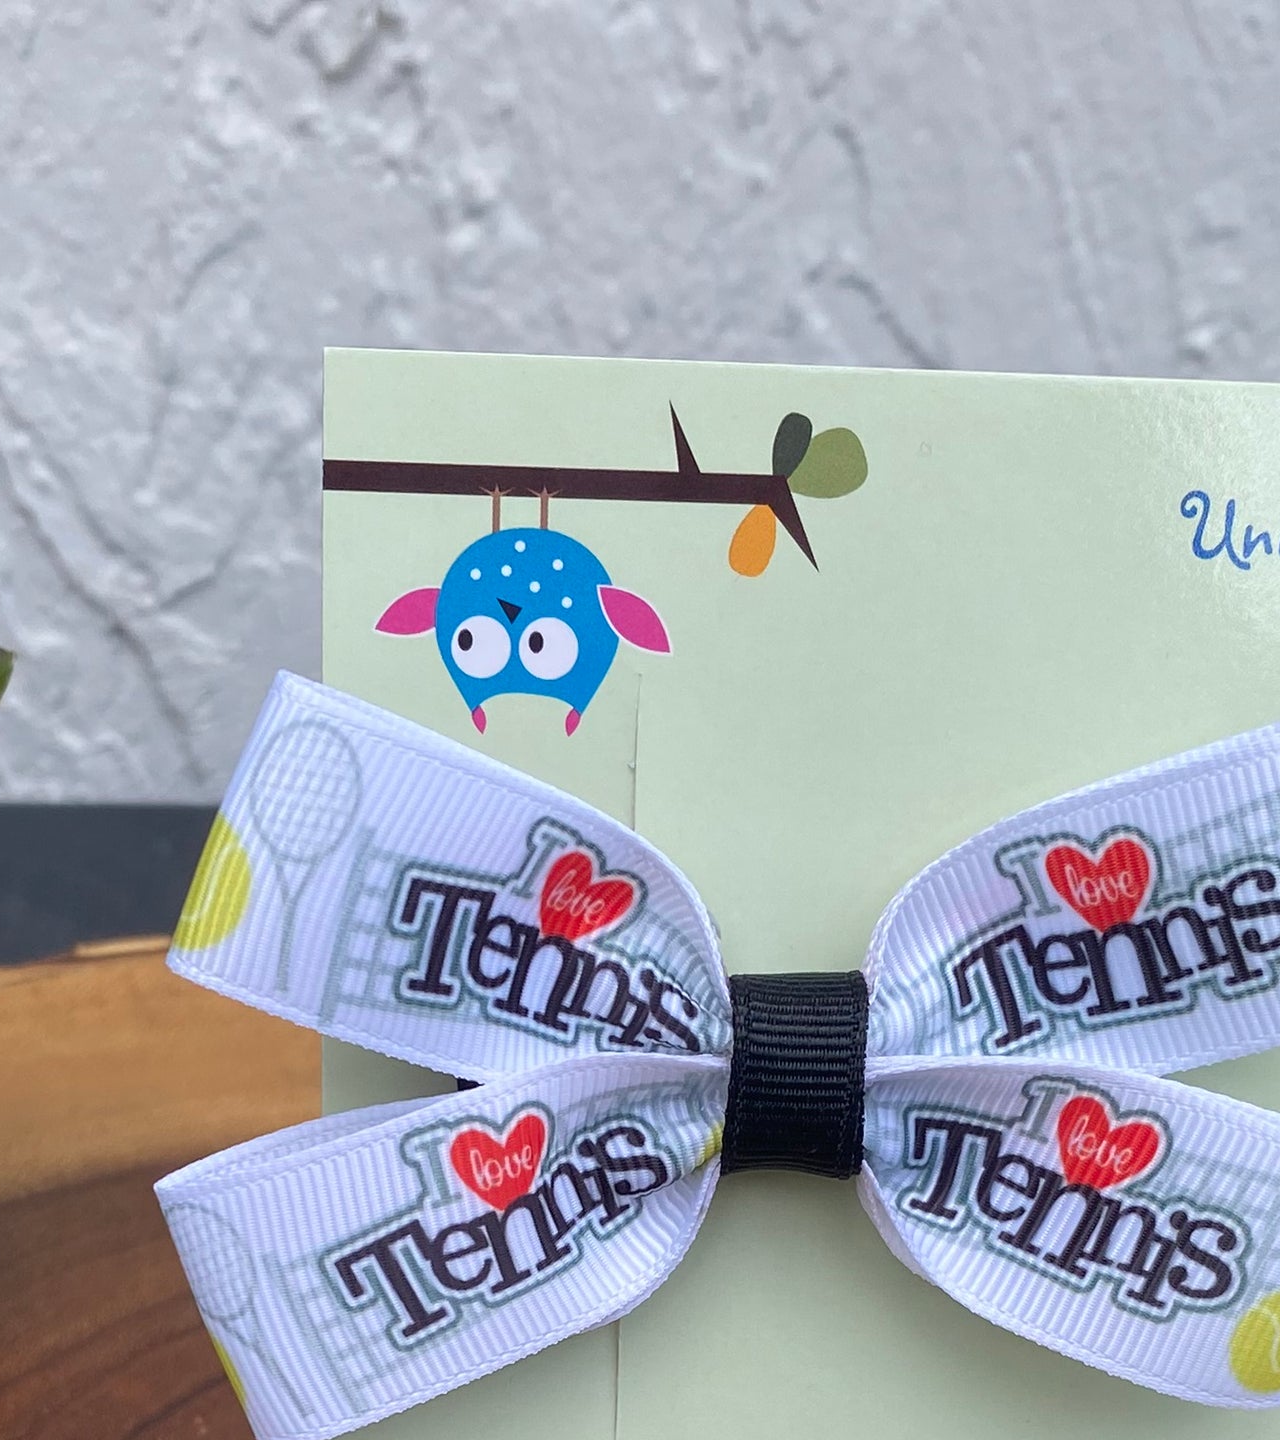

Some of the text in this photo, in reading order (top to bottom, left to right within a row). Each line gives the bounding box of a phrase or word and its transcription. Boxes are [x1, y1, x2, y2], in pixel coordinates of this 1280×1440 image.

[548, 871, 606, 924] love
[1064, 865, 1136, 906] love
[400, 878, 700, 1053] Tennis
[469, 1143, 534, 1191] love
[1066, 1114, 1133, 1175] love
[334, 1126, 668, 1337] Tennis
[909, 1117, 1236, 1309] Tennis
